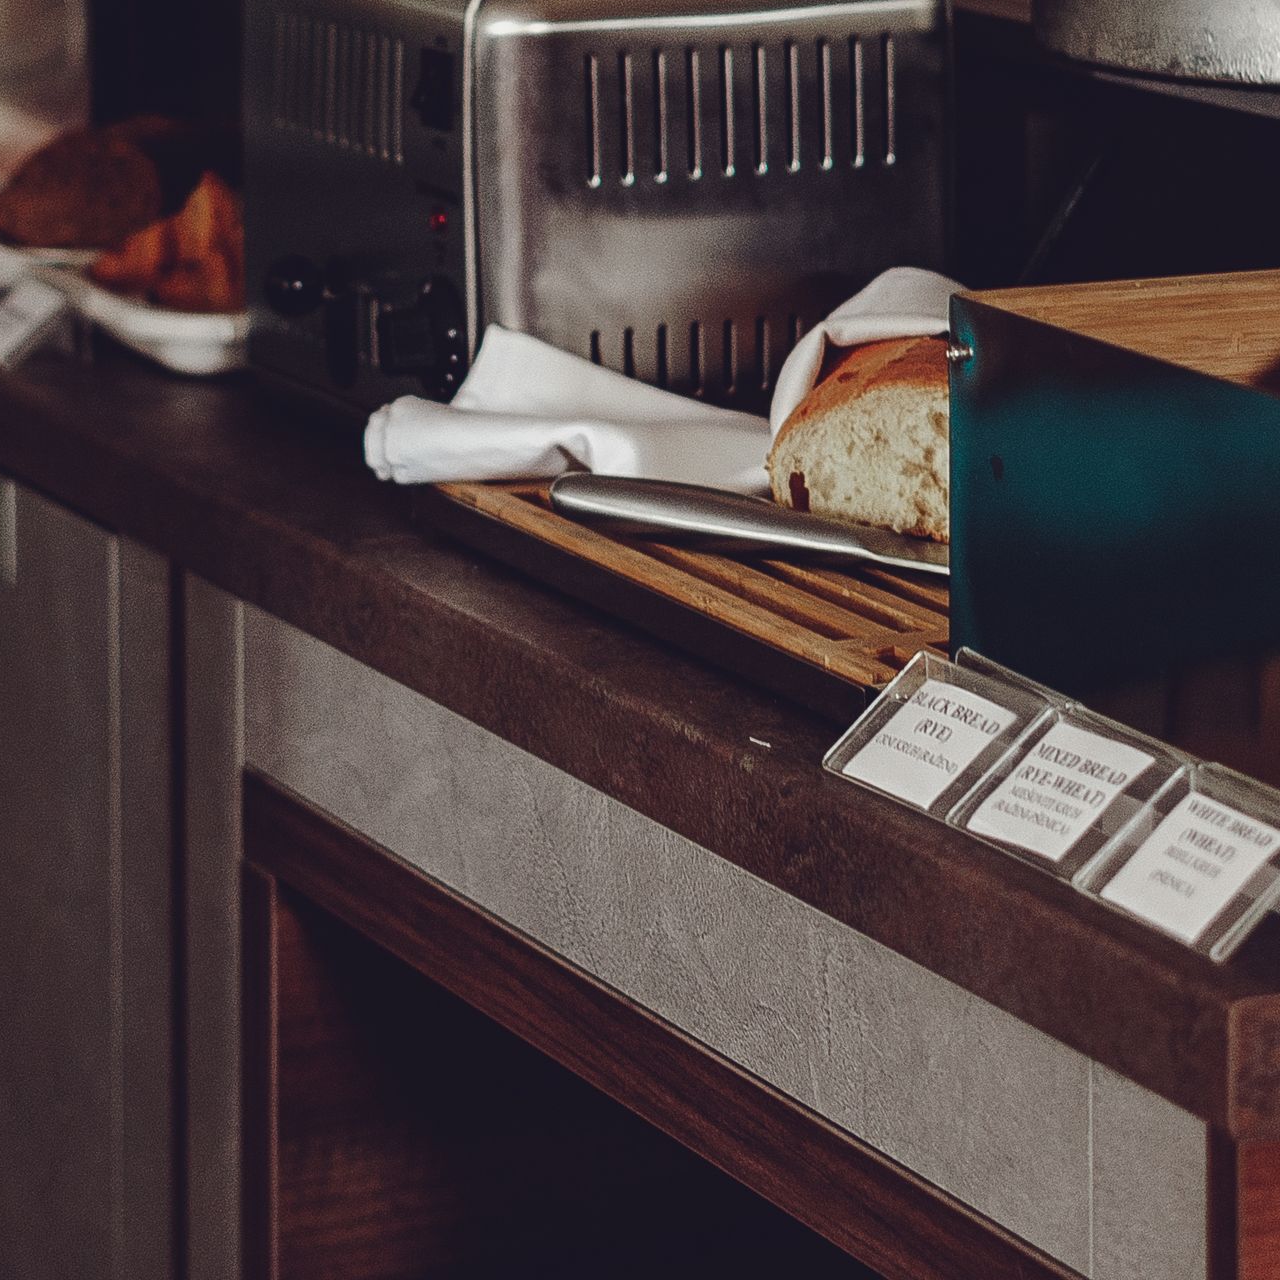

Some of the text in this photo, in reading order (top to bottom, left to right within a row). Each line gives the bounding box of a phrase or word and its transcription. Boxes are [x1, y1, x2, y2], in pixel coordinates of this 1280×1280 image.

[911, 689, 1001, 735] BLACK BREAD
[913, 718, 953, 743] (RYE)
[1035, 743, 1128, 785] MIXED BREAD
[1227, 821, 1273, 847] BREAD
